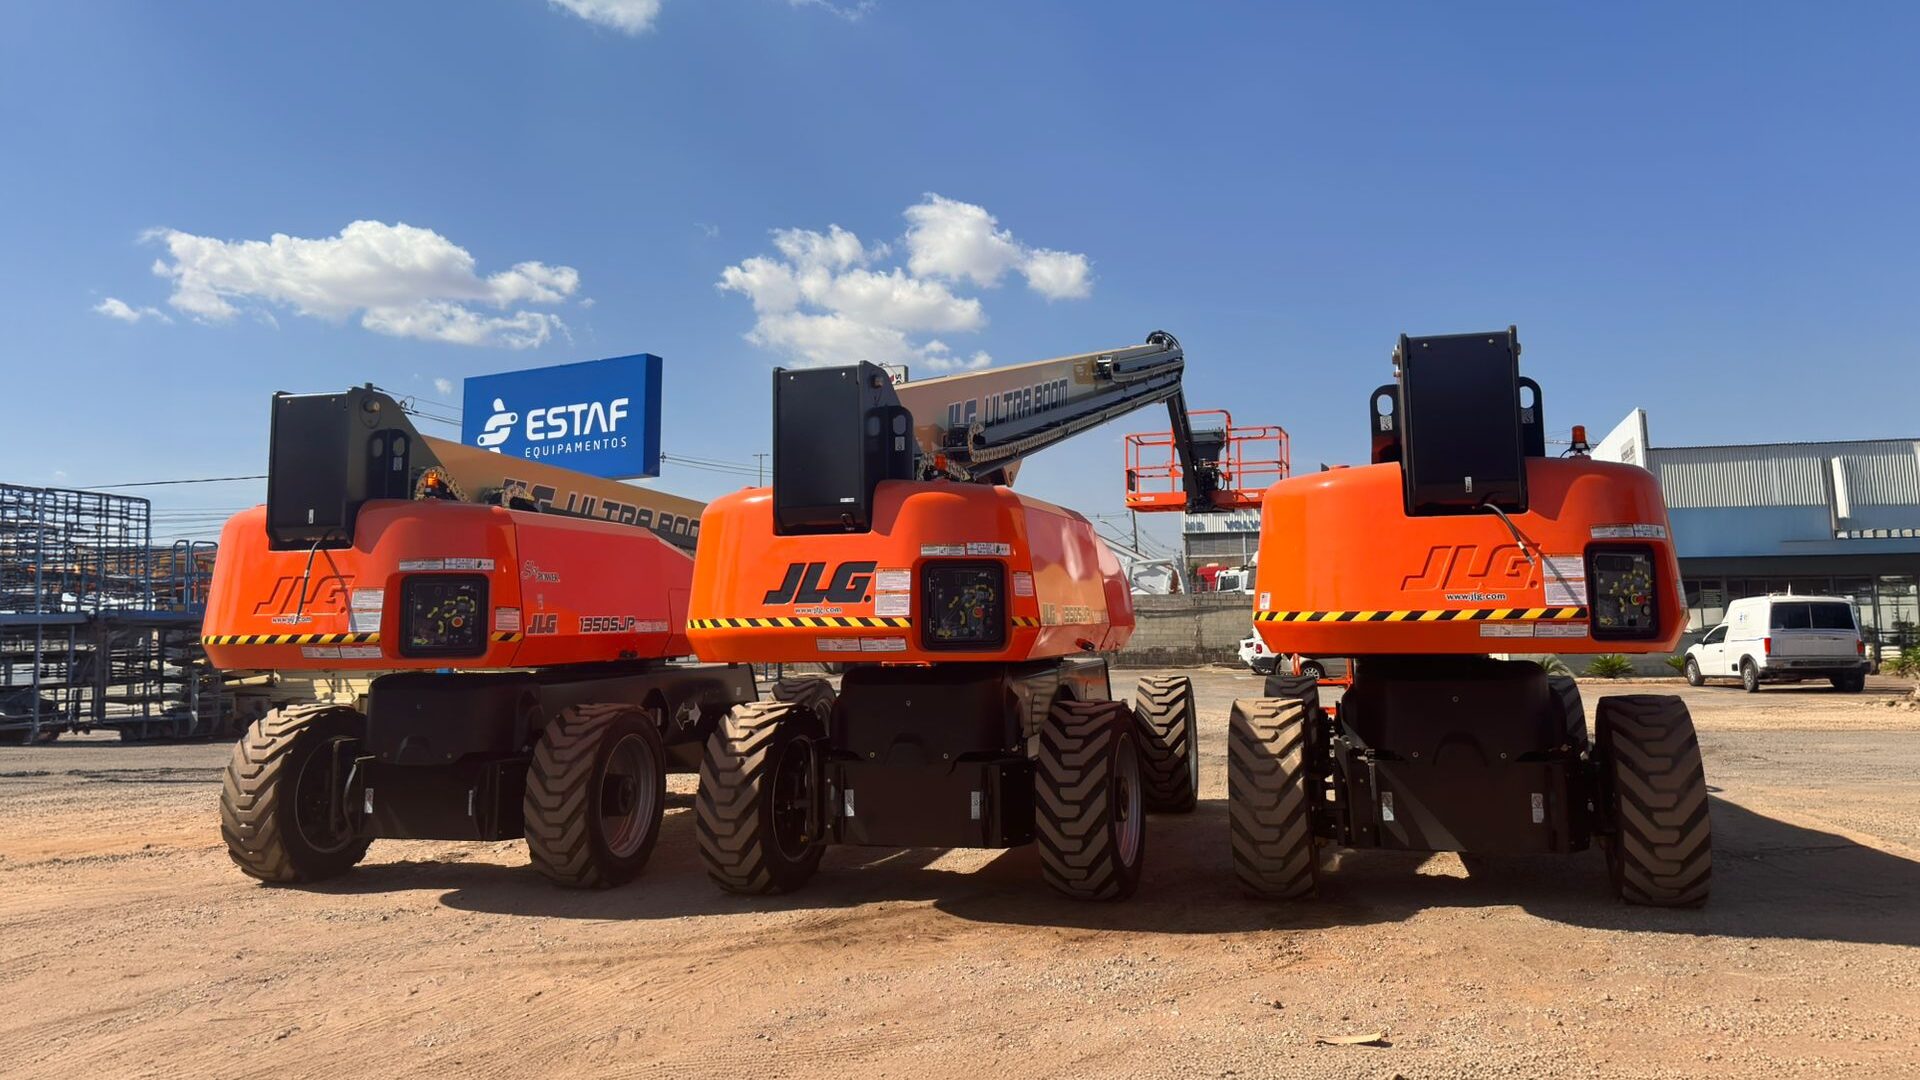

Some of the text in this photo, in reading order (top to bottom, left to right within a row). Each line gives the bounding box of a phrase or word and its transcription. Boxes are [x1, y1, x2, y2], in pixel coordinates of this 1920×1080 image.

[984, 386, 1032, 428] ULTRA
[1034, 378, 1068, 415] BOOM
[526, 398, 629, 441] ESTAF
[524, 436, 628, 459] EQUIPAMENTOS
[1446, 591, 1506, 601] www.jlg.com
[528, 614, 558, 635] JLG
[579, 616, 636, 633] 1350SJP
